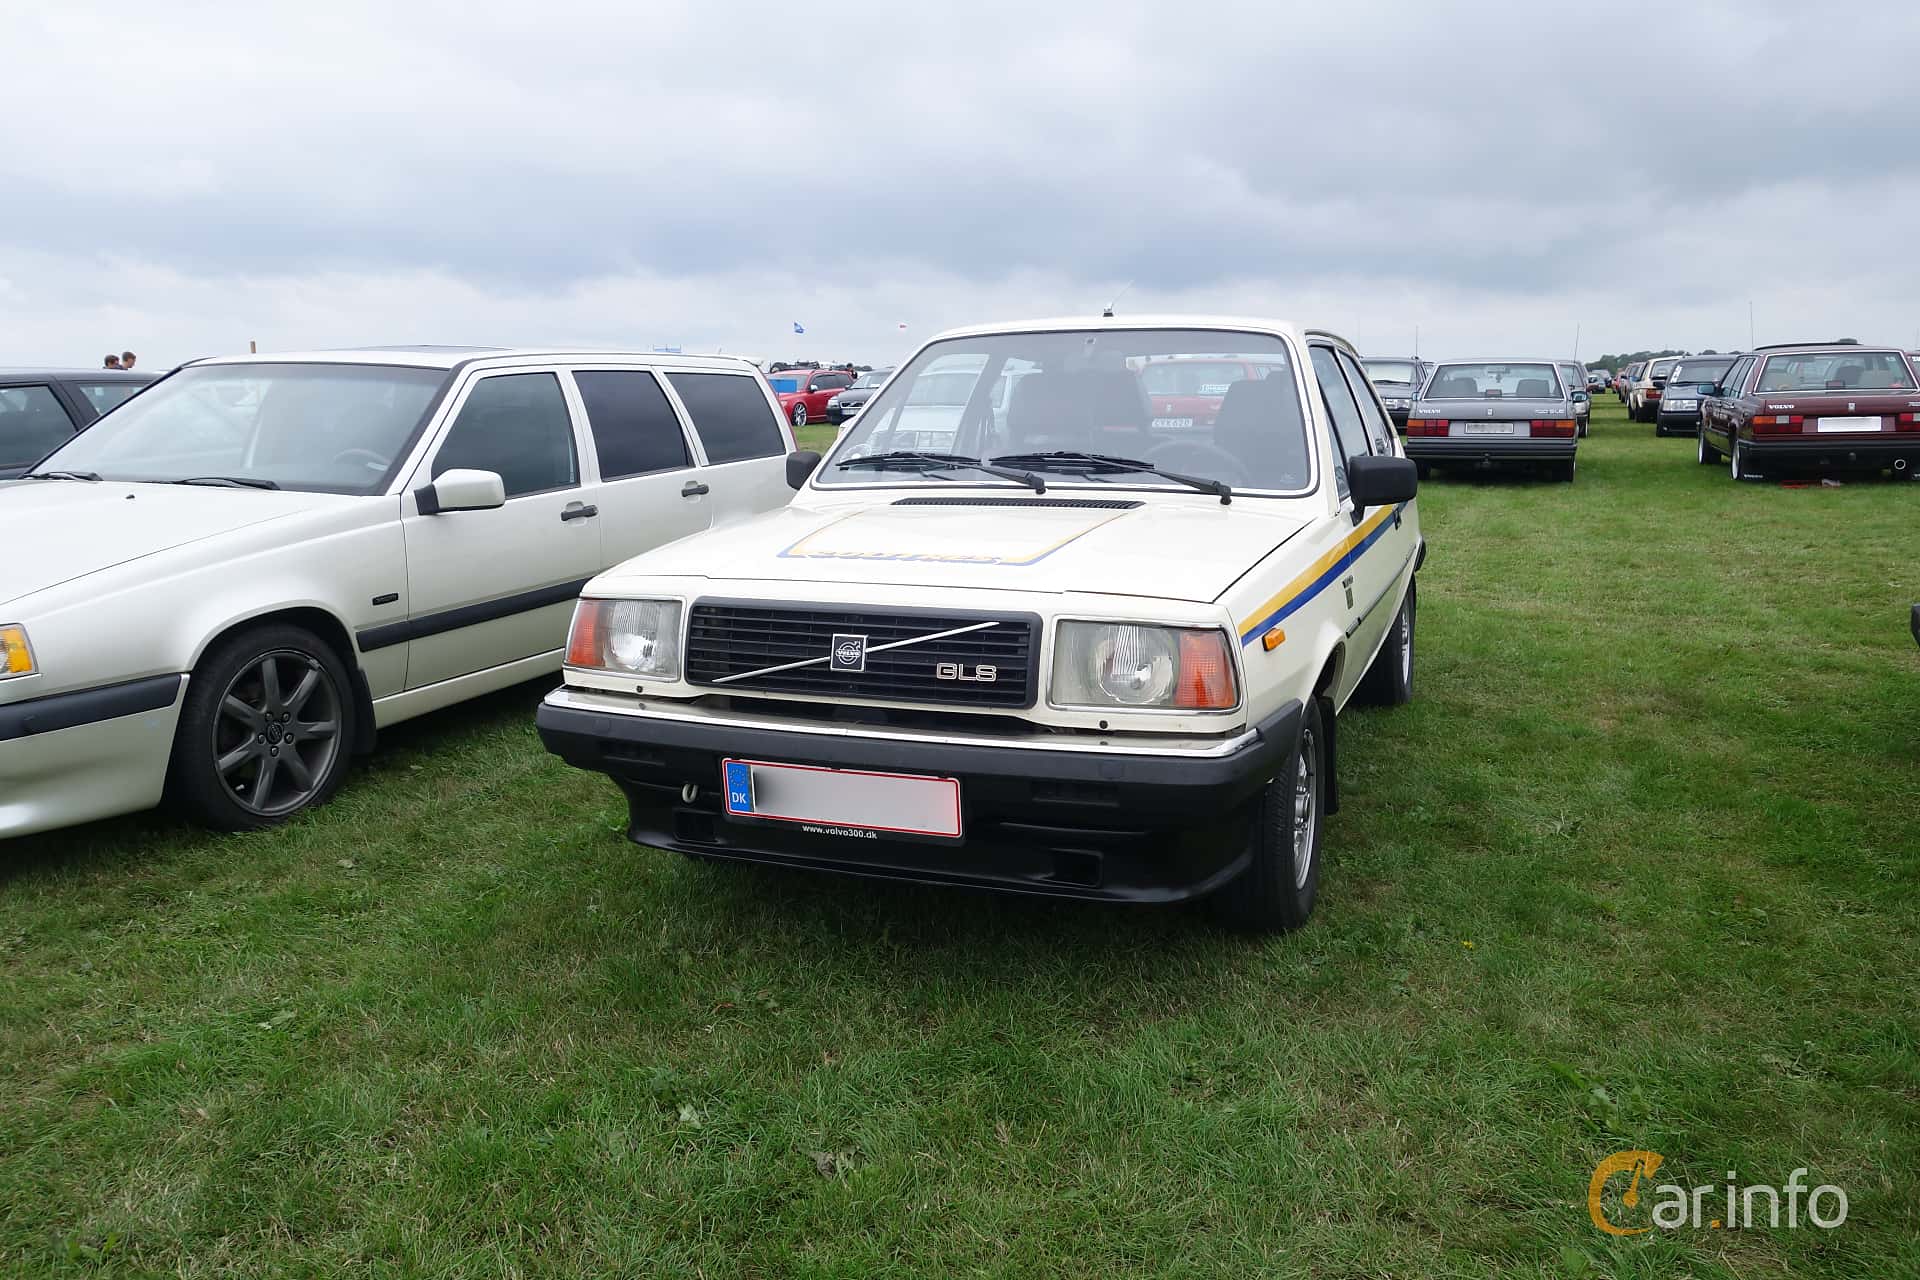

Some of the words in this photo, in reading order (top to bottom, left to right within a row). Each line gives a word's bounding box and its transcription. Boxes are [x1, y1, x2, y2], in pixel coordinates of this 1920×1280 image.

[936, 662, 997, 682] GLS
[731, 791, 747, 804] DK
[801, 824, 878, 839] www.volvo300.dk
